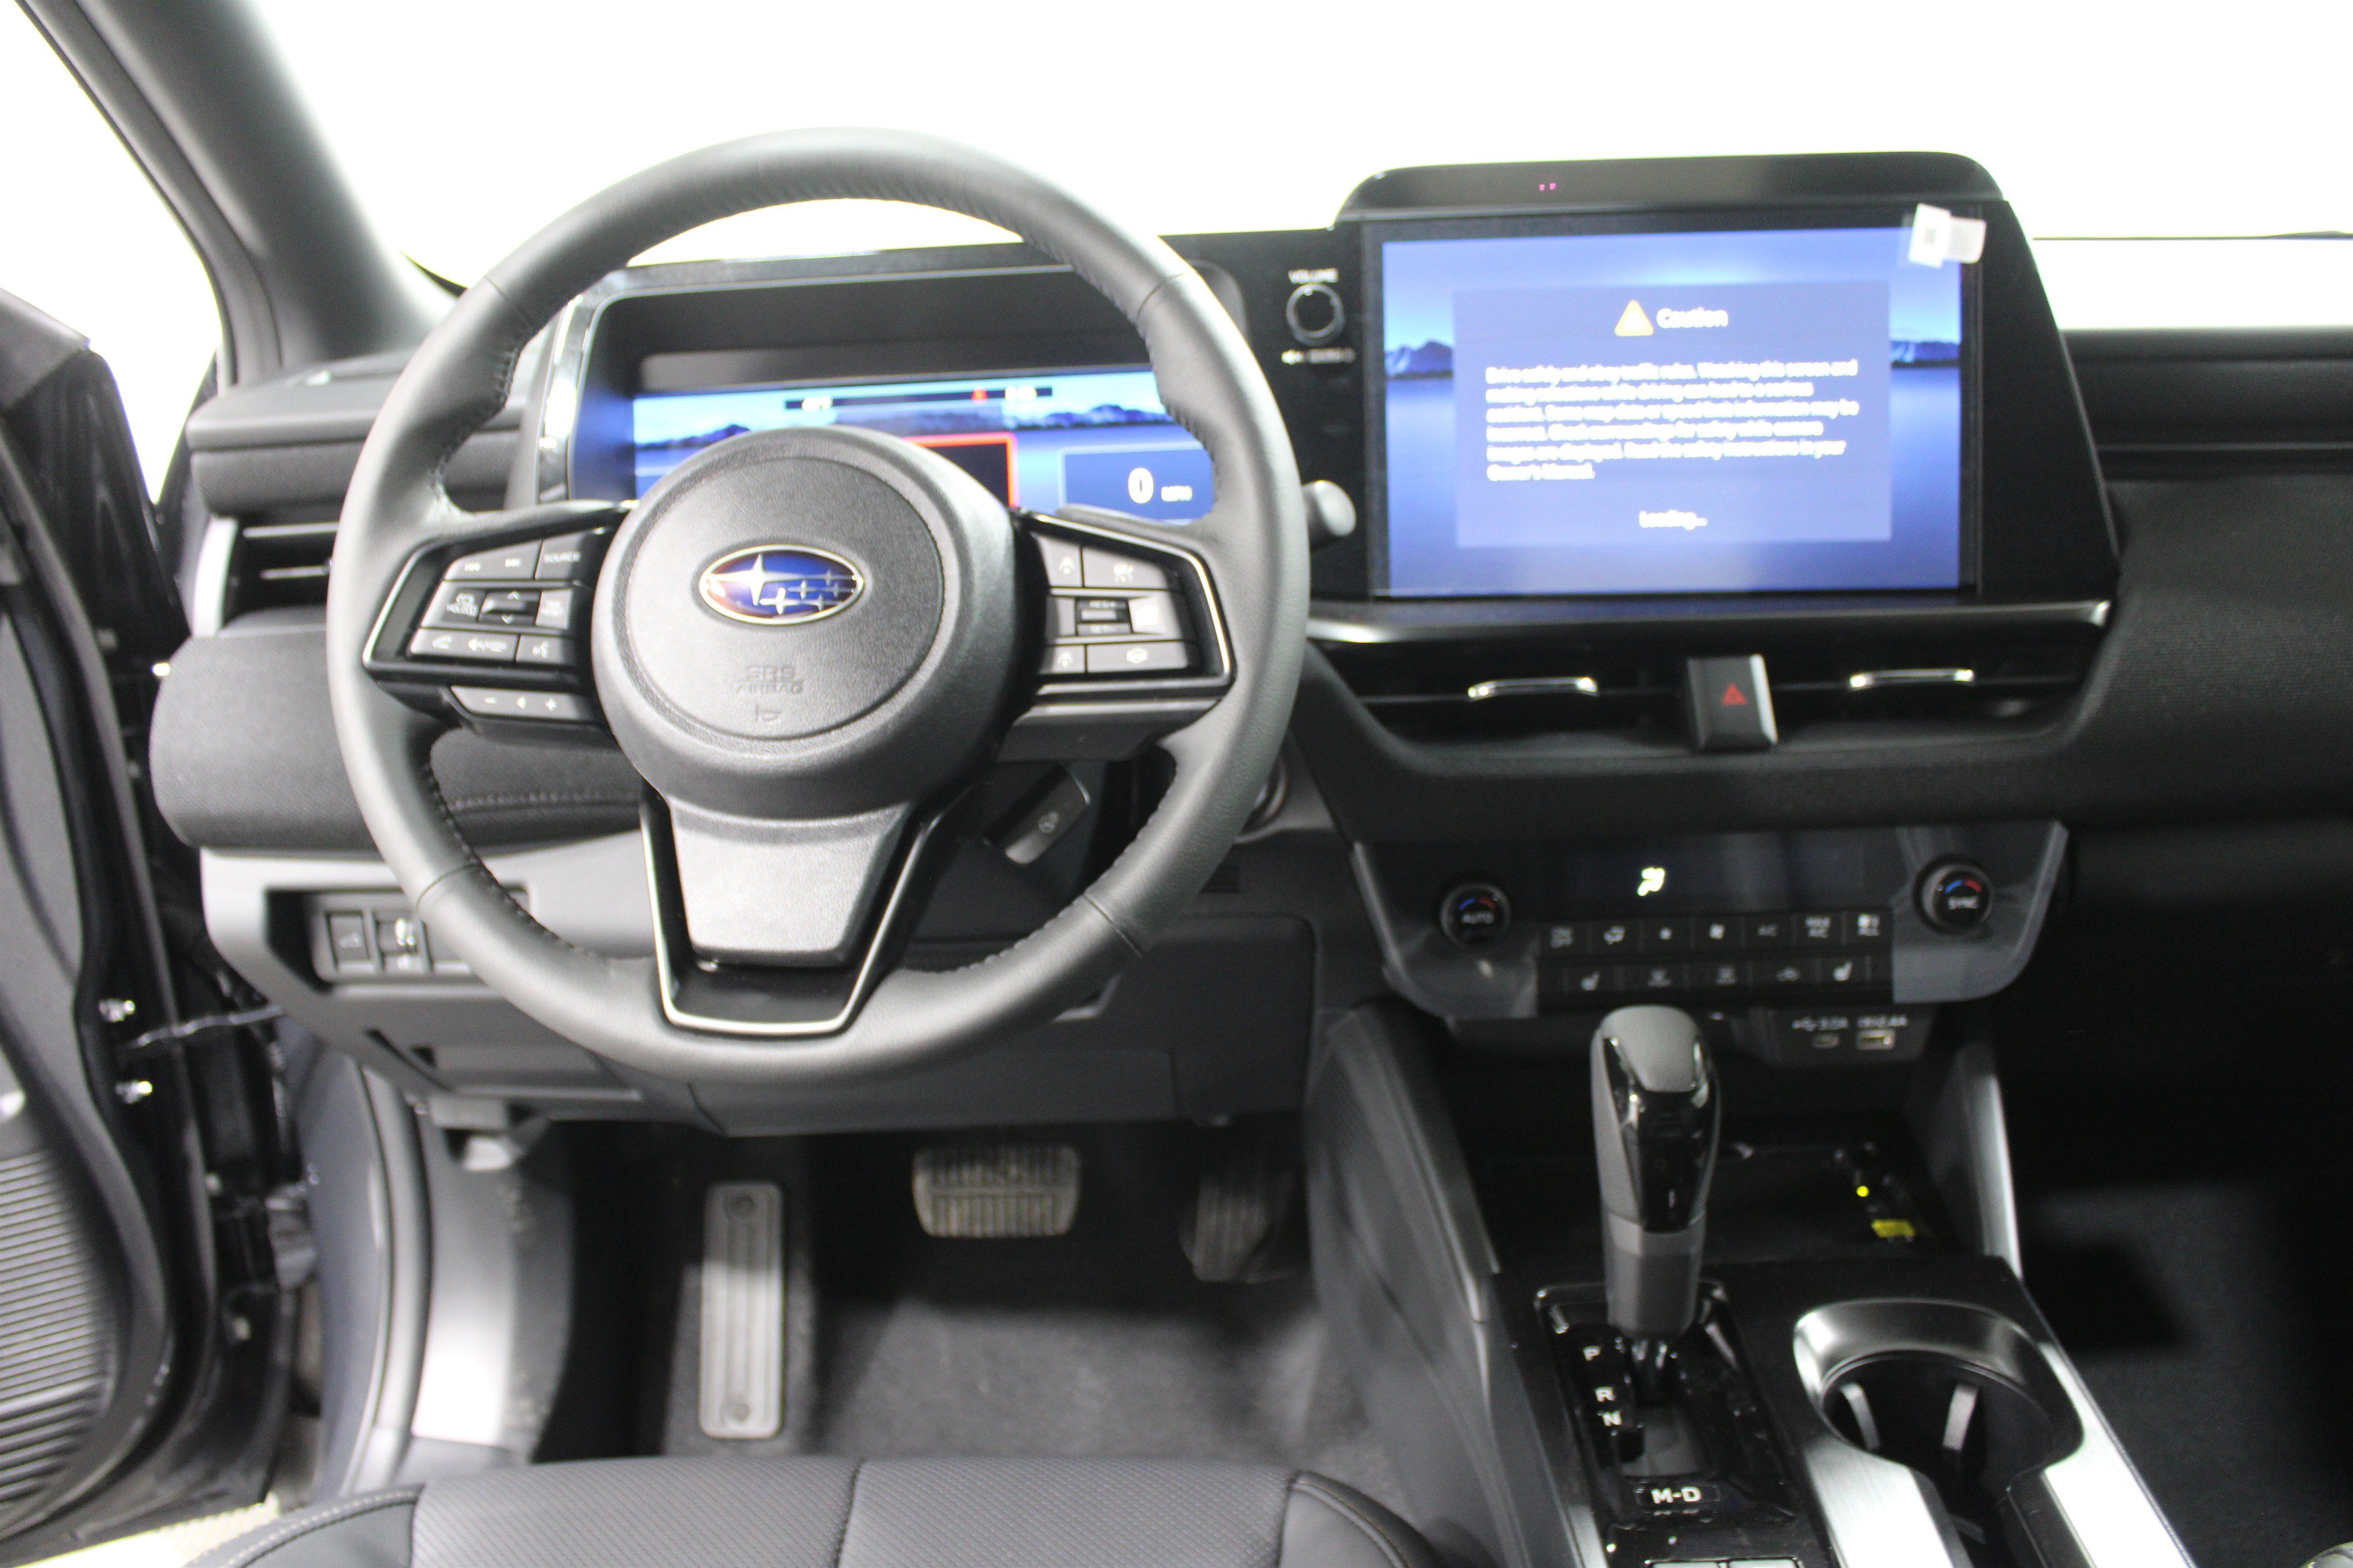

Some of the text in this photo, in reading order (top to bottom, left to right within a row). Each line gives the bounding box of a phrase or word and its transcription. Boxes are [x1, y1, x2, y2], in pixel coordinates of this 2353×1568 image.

[1288, 268, 1339, 284] VOLUME
[1657, 307, 1728, 329] Caution
[1128, 468, 1154, 504] 0
[543, 552, 581, 563] SOURCE
[1583, 1346, 1601, 1361] P
[1594, 1386, 1615, 1402] R
[1603, 1410, 1622, 1426] N
